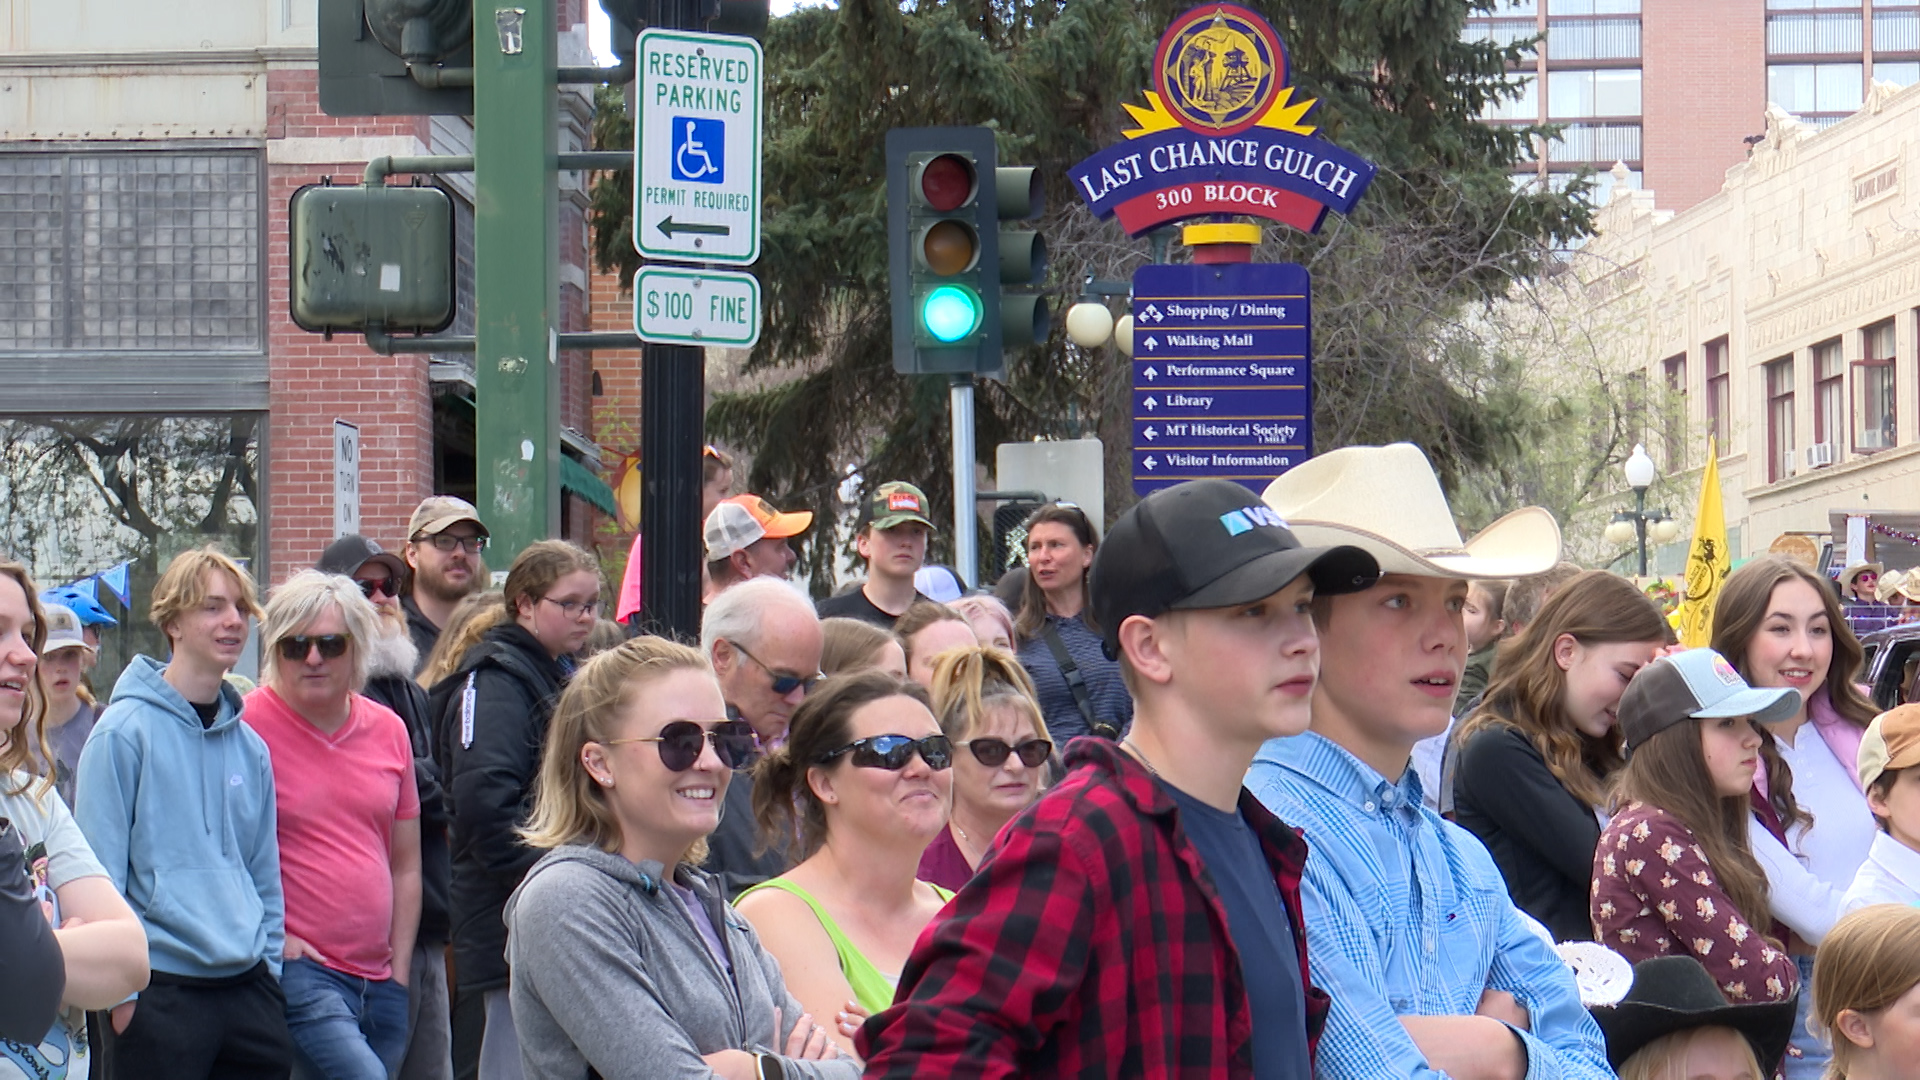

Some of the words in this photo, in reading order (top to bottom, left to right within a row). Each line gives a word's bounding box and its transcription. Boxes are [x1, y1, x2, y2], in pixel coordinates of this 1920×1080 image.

[649, 51, 749, 84] RESERVED
[656, 83, 742, 114] PARKING
[1079, 153, 1143, 203] LAST
[1149, 139, 1259, 173] CHANCE
[1264, 144, 1359, 199] GULCH
[646, 186, 686, 207] PERMIT
[694, 190, 749, 212] REQUIRED
[1156, 187, 1193, 210] 300
[1204, 184, 1280, 209] BLOCK
[646, 289, 693, 320] $100
[710, 294, 748, 325] FINE
[1166, 303, 1230, 321] Shopping
[1239, 303, 1286, 320] Dining
[1166, 334, 1220, 350] Walking
[1223, 334, 1254, 346] Mall
[1166, 364, 1247, 377] Performance
[1249, 363, 1295, 380] Square
[1166, 395, 1214, 410] Library
[1165, 424, 1188, 437] MT
[1191, 423, 1250, 437] Historical
[1252, 423, 1298, 440] Society
[341, 435, 353, 464] NO
[1166, 453, 1209, 467] Visitor
[1211, 453, 1290, 467] Information
[343, 503, 352, 524] ON
